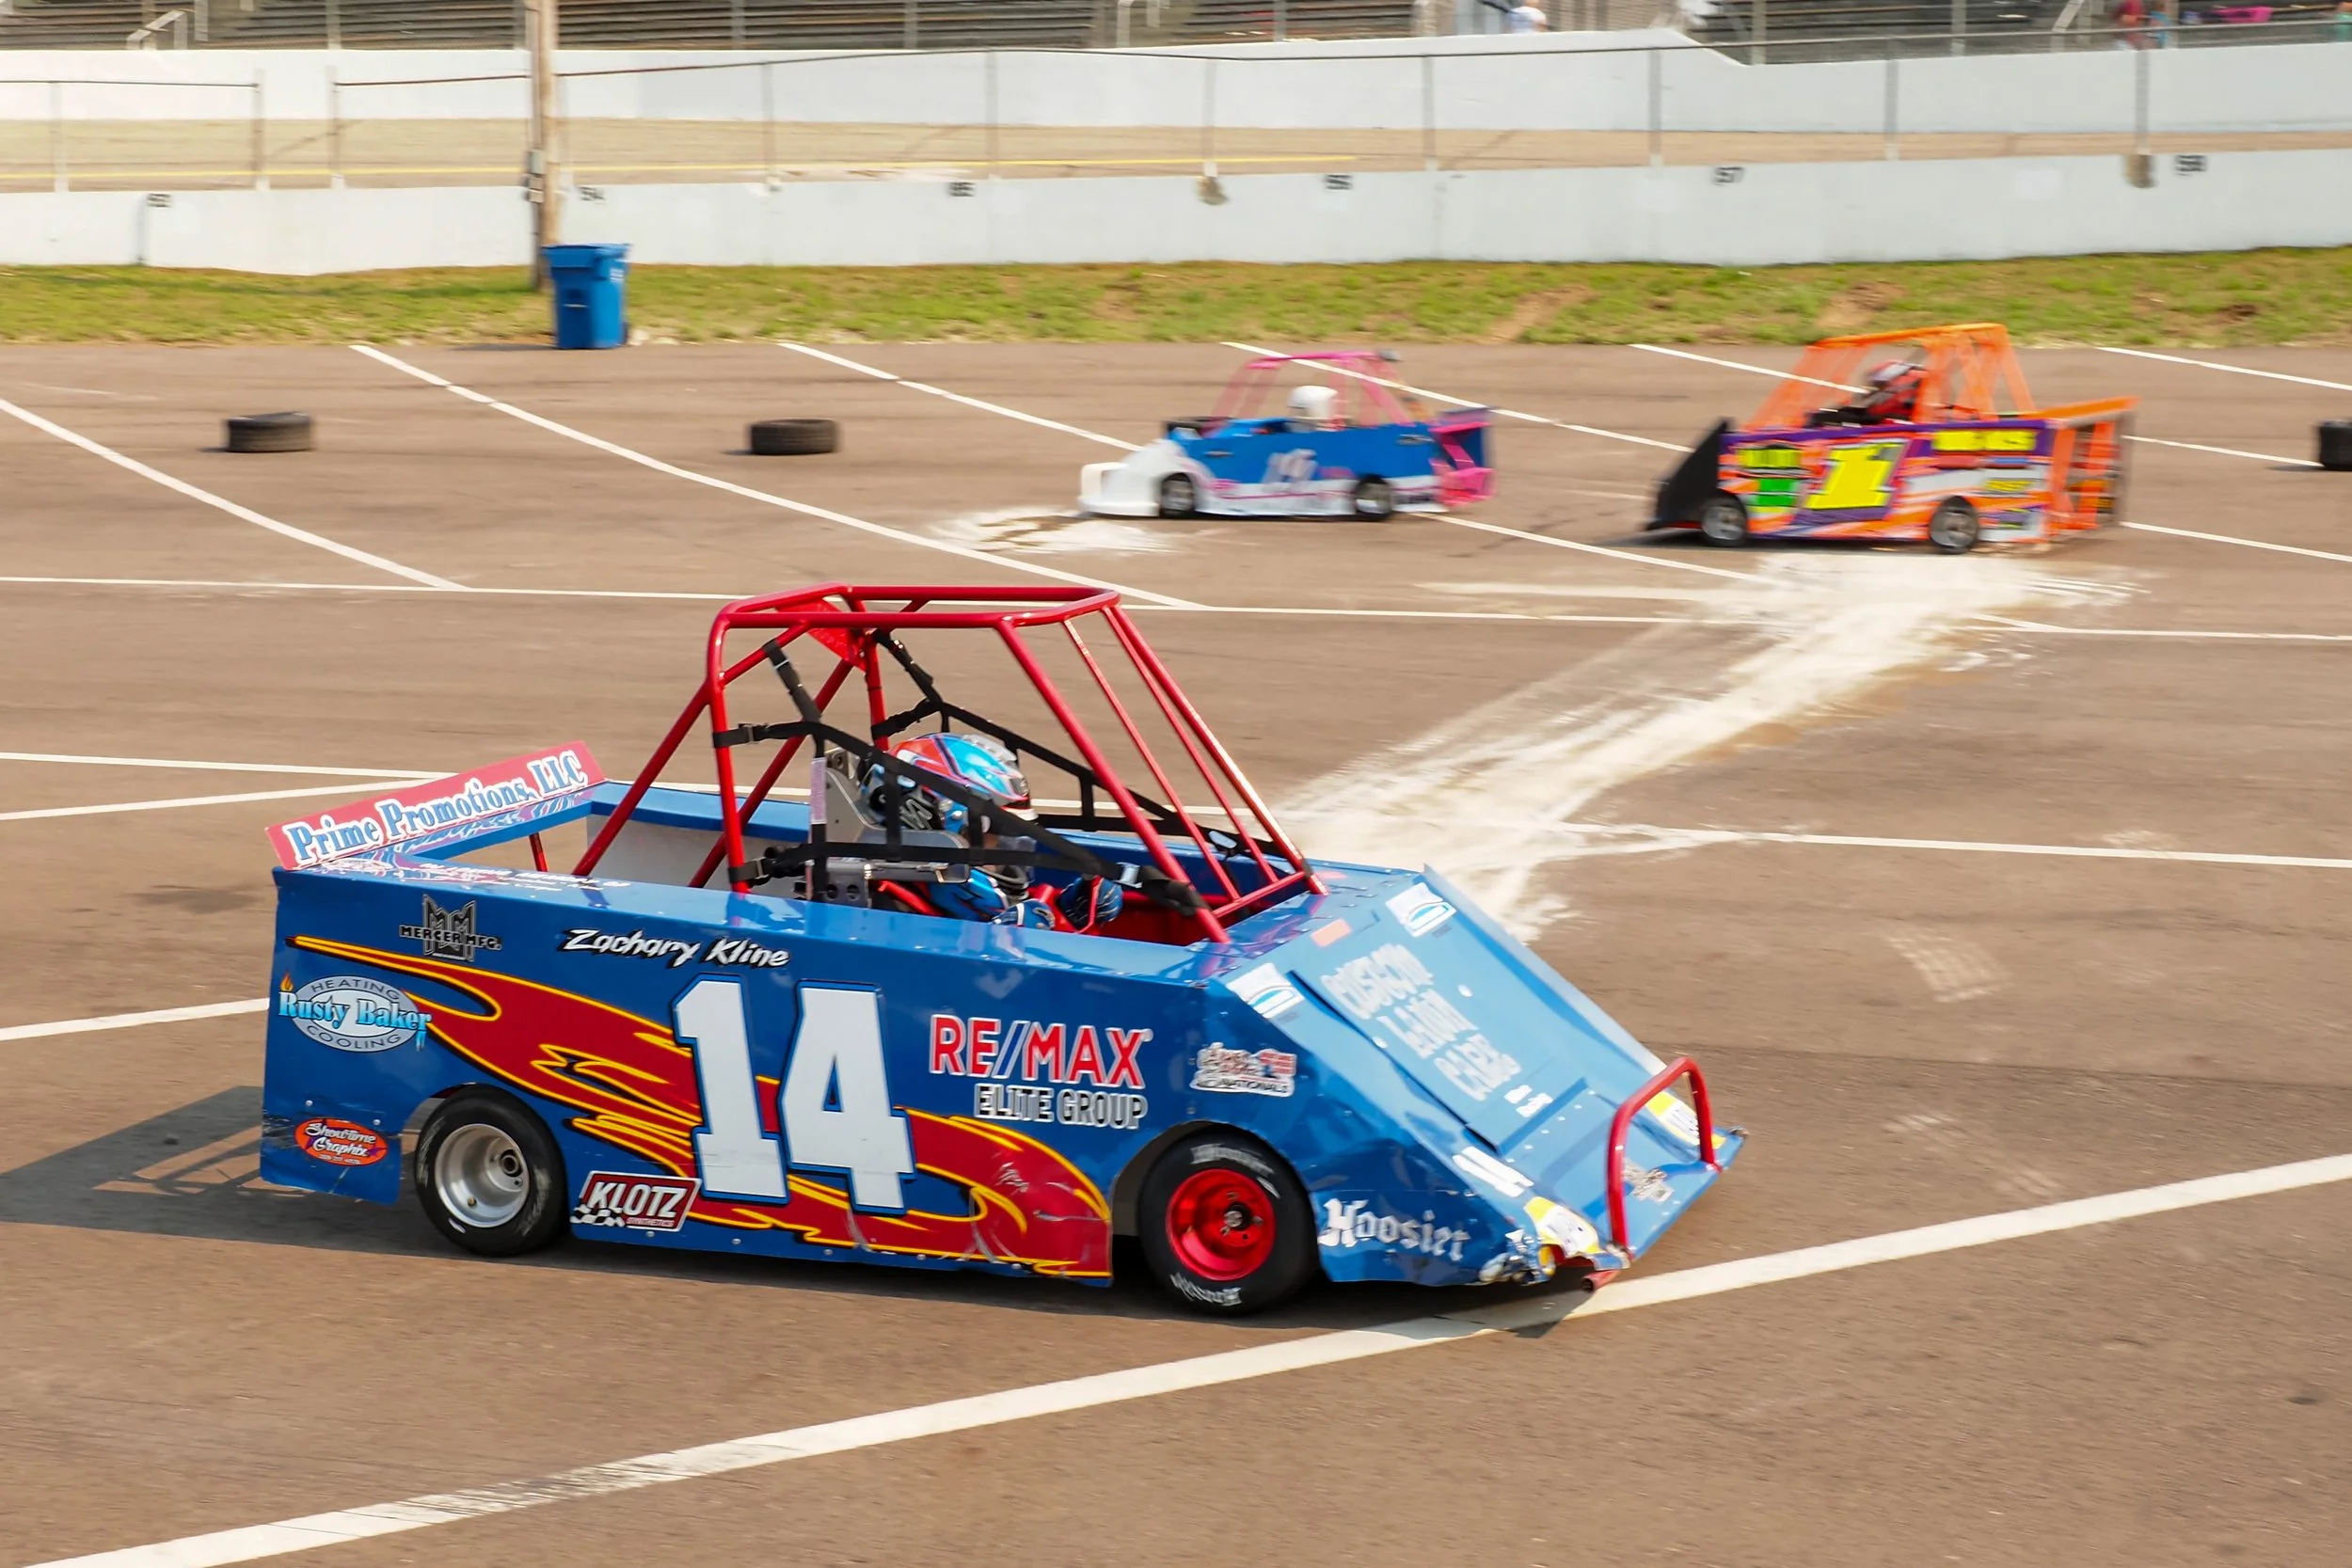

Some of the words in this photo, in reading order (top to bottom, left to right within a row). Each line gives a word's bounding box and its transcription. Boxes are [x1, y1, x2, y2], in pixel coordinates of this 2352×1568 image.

[1804, 446, 1893, 510] 1
[284, 815, 382, 863] Prime
[376, 778, 541, 837] Promotions,
[528, 751, 588, 794] LLC
[400, 926, 461, 943] MERCER
[562, 928, 702, 967] Zachary
[705, 936, 790, 967] Kline
[311, 978, 400, 1000] HEATING
[278, 991, 350, 1030] Rusty
[357, 998, 433, 1032] Baker
[307, 1025, 401, 1050] COOLING
[673, 973, 915, 1214] 14
[974, 1083, 1055, 1123] ELITE
[1057, 1088, 1149, 1129] GROUP
[586, 1181, 689, 1218] KLOTZ
[1317, 1197, 1471, 1261] Hoosier
